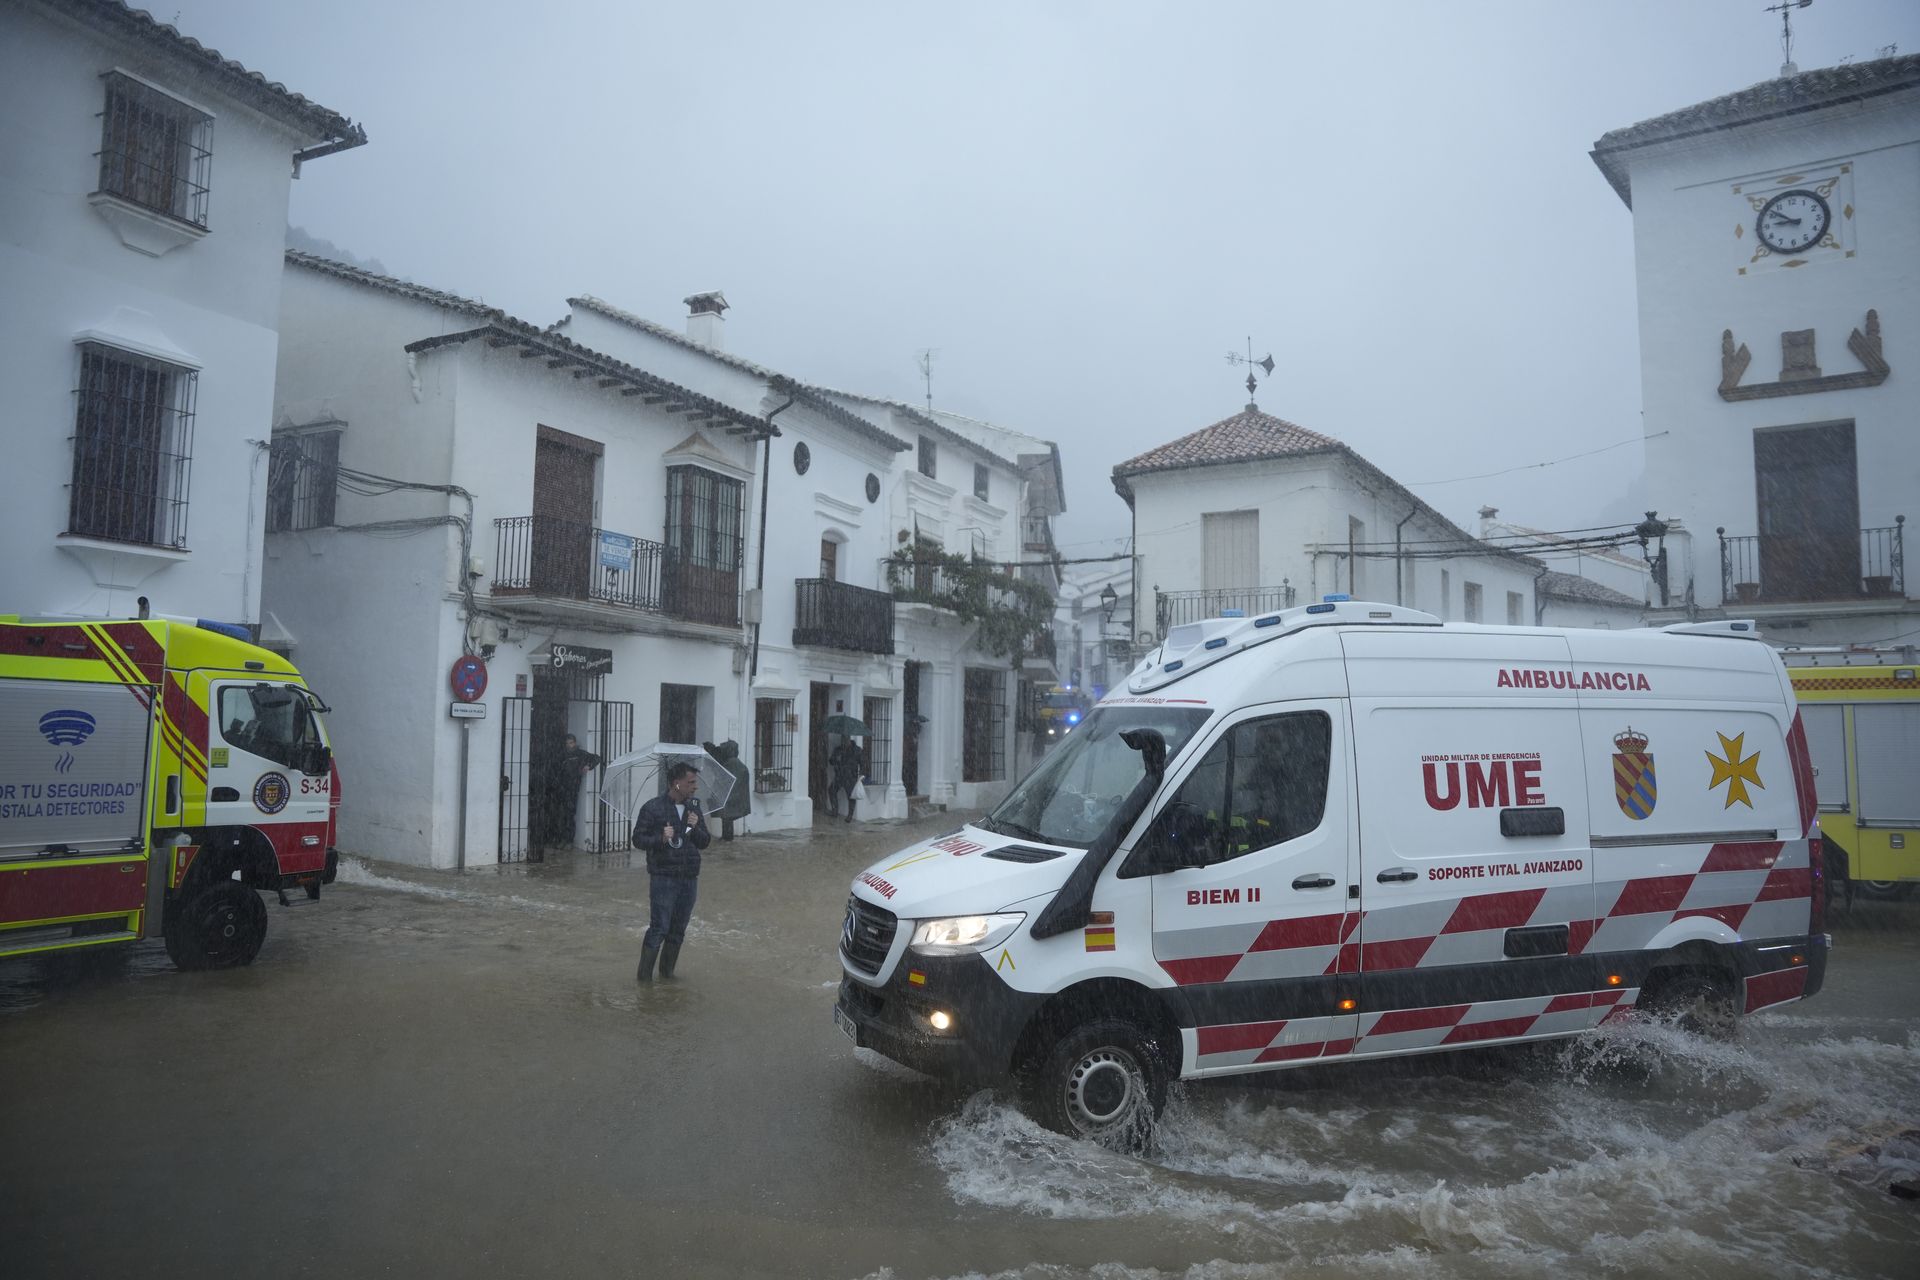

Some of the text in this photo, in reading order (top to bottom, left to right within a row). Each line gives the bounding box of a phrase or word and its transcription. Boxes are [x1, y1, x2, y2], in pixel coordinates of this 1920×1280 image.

[1497, 669, 1651, 691] AMBULANCIA
[1492, 752, 1541, 760] EMERGENCIAS
[21, 784, 42, 799] TU
[301, 778, 329, 794] S-34
[1422, 760, 1545, 811] UME
[46, 801, 125, 817] DETECTORES
[1428, 859, 1583, 881] SOPORTE VITAL AVANZADO
[1187, 888, 1260, 905] BIEM II
